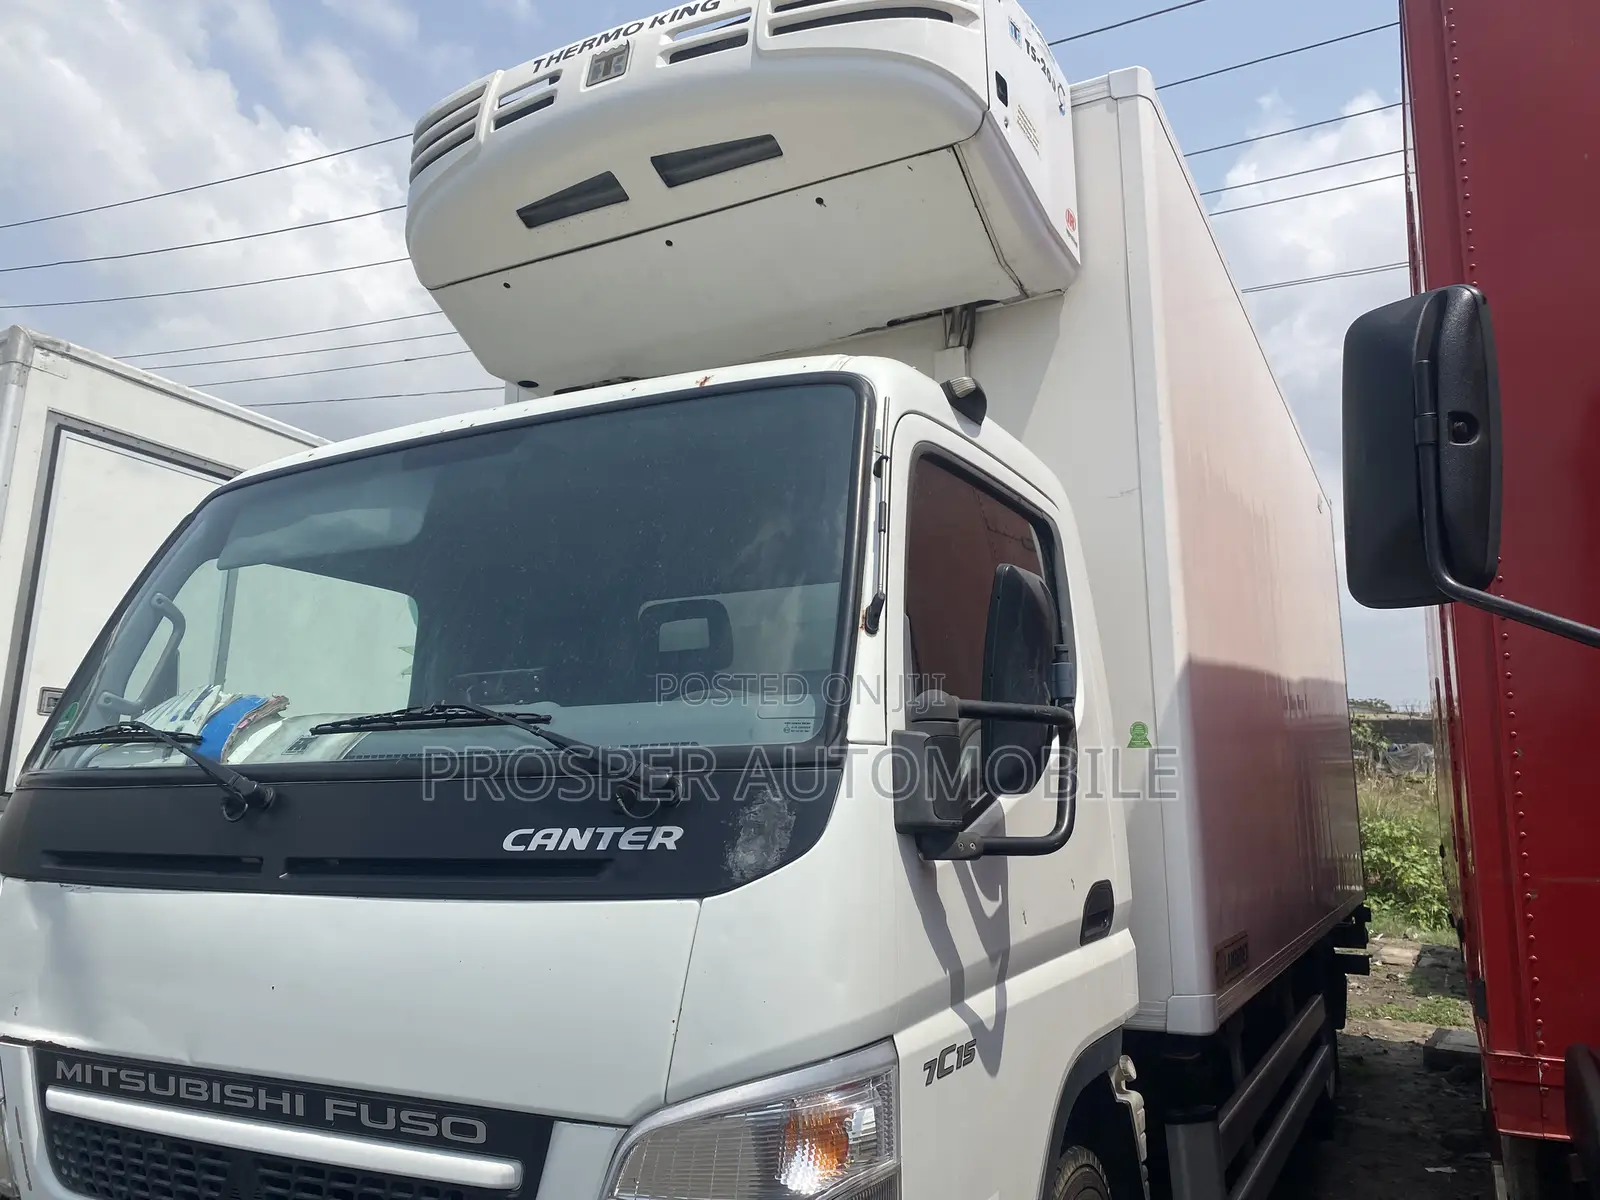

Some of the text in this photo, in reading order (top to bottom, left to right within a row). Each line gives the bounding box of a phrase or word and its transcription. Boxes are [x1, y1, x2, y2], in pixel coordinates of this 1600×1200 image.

[533, 0, 720, 73] THERMO KING
[502, 826, 684, 851] CANTER
[923, 1039, 977, 1087] 7C15
[56, 1060, 487, 1144] MITSUBISHI FUSO
